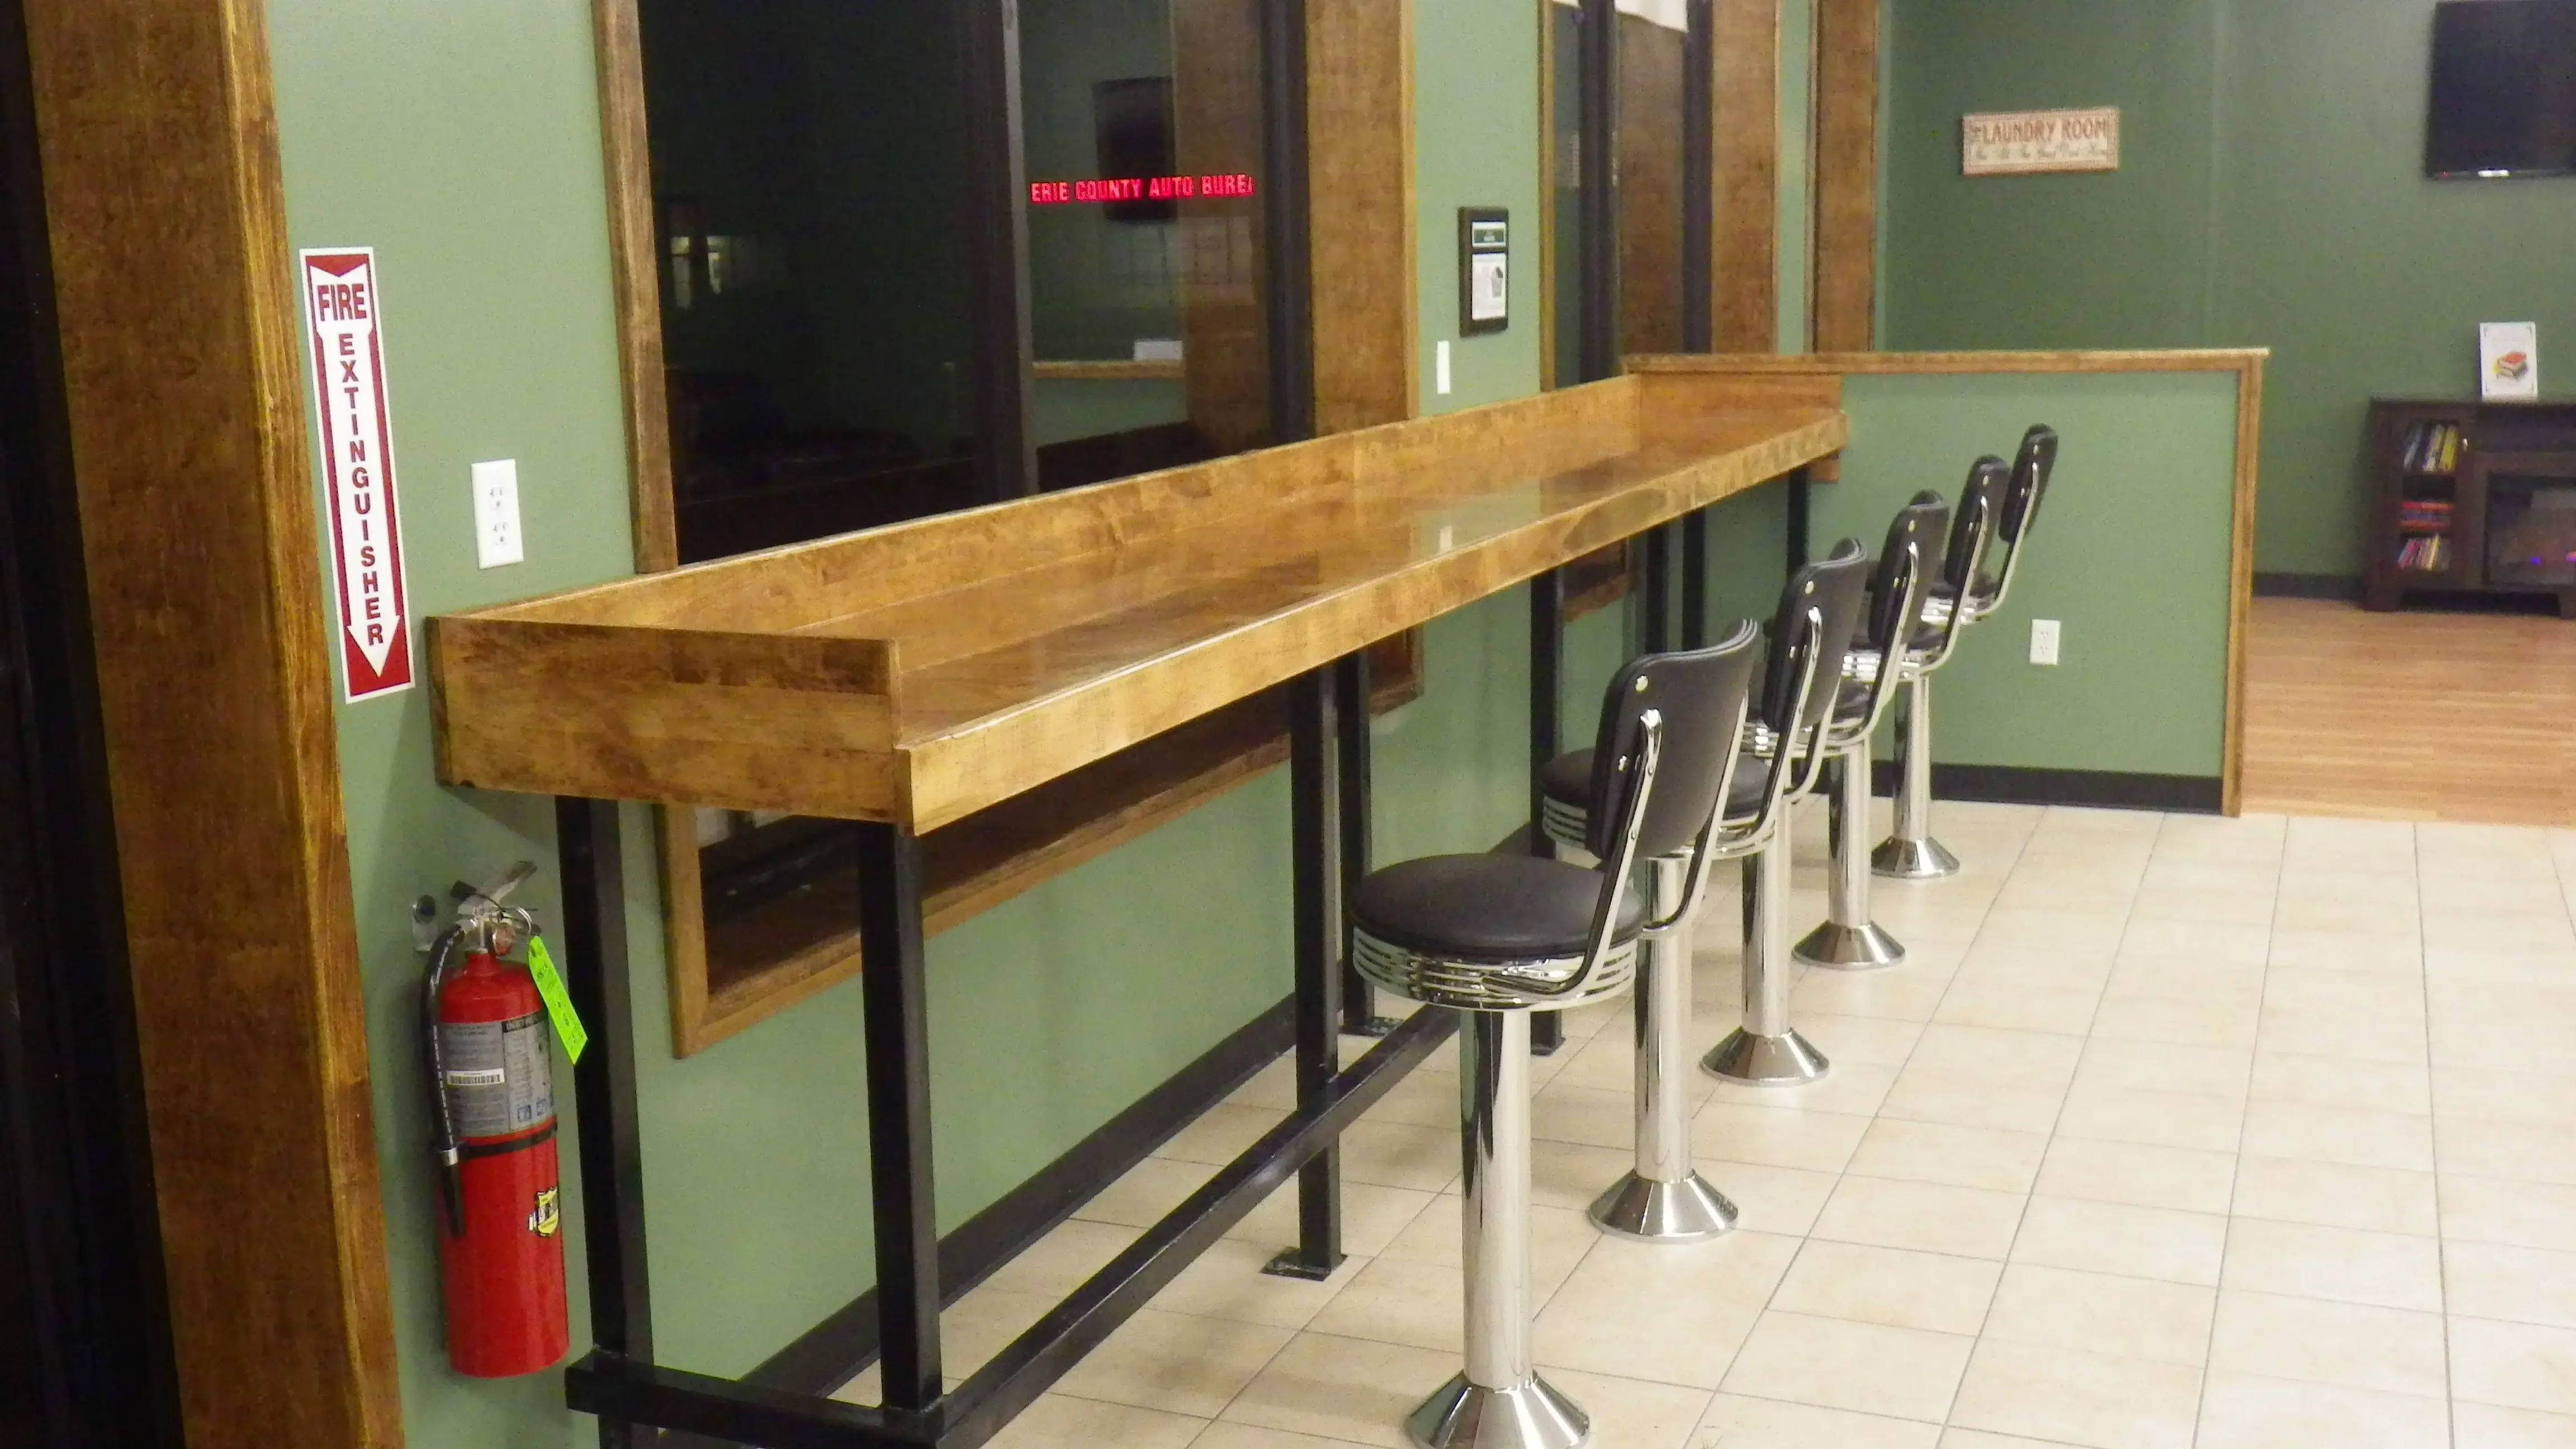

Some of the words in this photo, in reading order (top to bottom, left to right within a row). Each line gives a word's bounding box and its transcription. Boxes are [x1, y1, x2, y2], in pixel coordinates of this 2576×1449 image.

[1983, 121, 2057, 144] LAUNDRY
[2062, 117, 2107, 140] ROOM
[1030, 182, 1069, 202] ERIE
[1075, 179, 1140, 200] COUNTY
[1149, 176, 1193, 197] AUTO
[318, 282, 367, 322] FIRE
[339, 332, 384, 647] EXTINGUISHER
